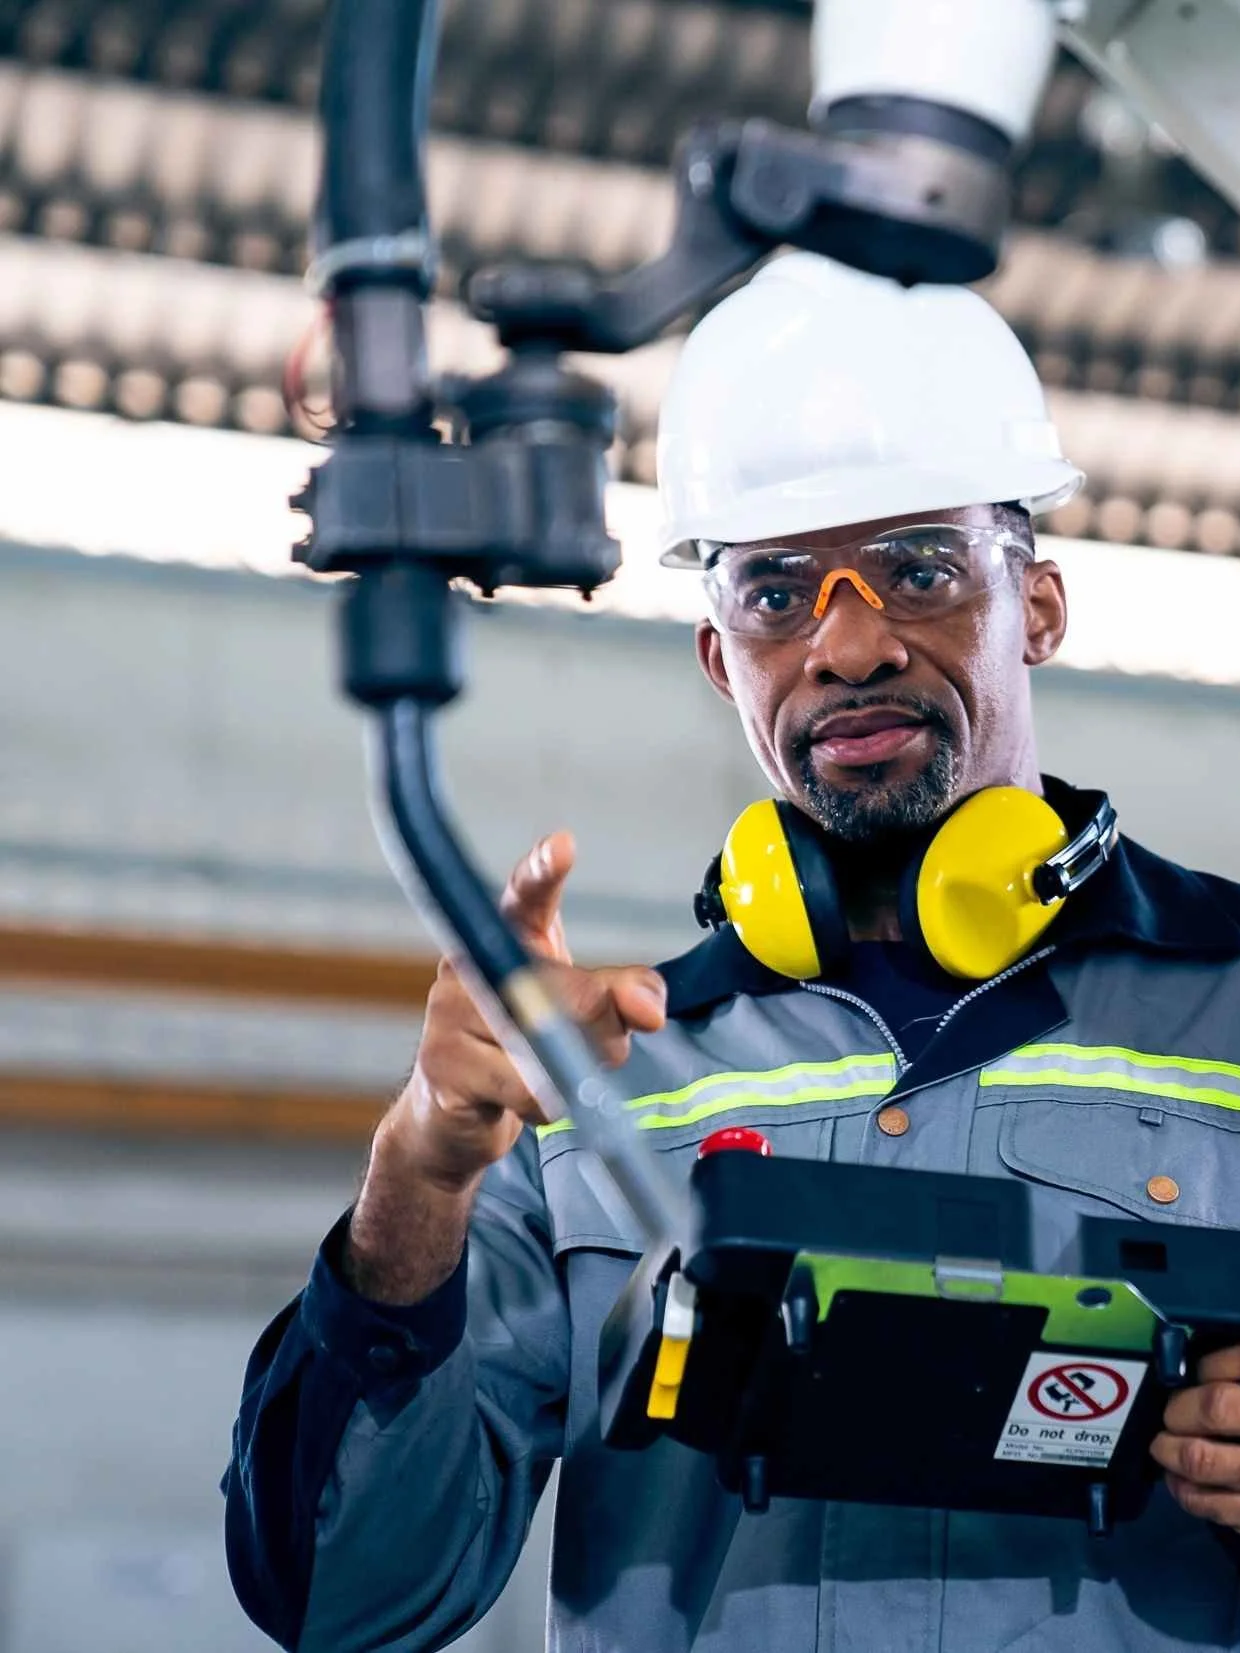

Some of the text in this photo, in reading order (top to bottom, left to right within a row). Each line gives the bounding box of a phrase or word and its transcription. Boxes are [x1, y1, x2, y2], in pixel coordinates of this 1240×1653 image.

[1008, 1423, 1113, 1445] Do not drop.
